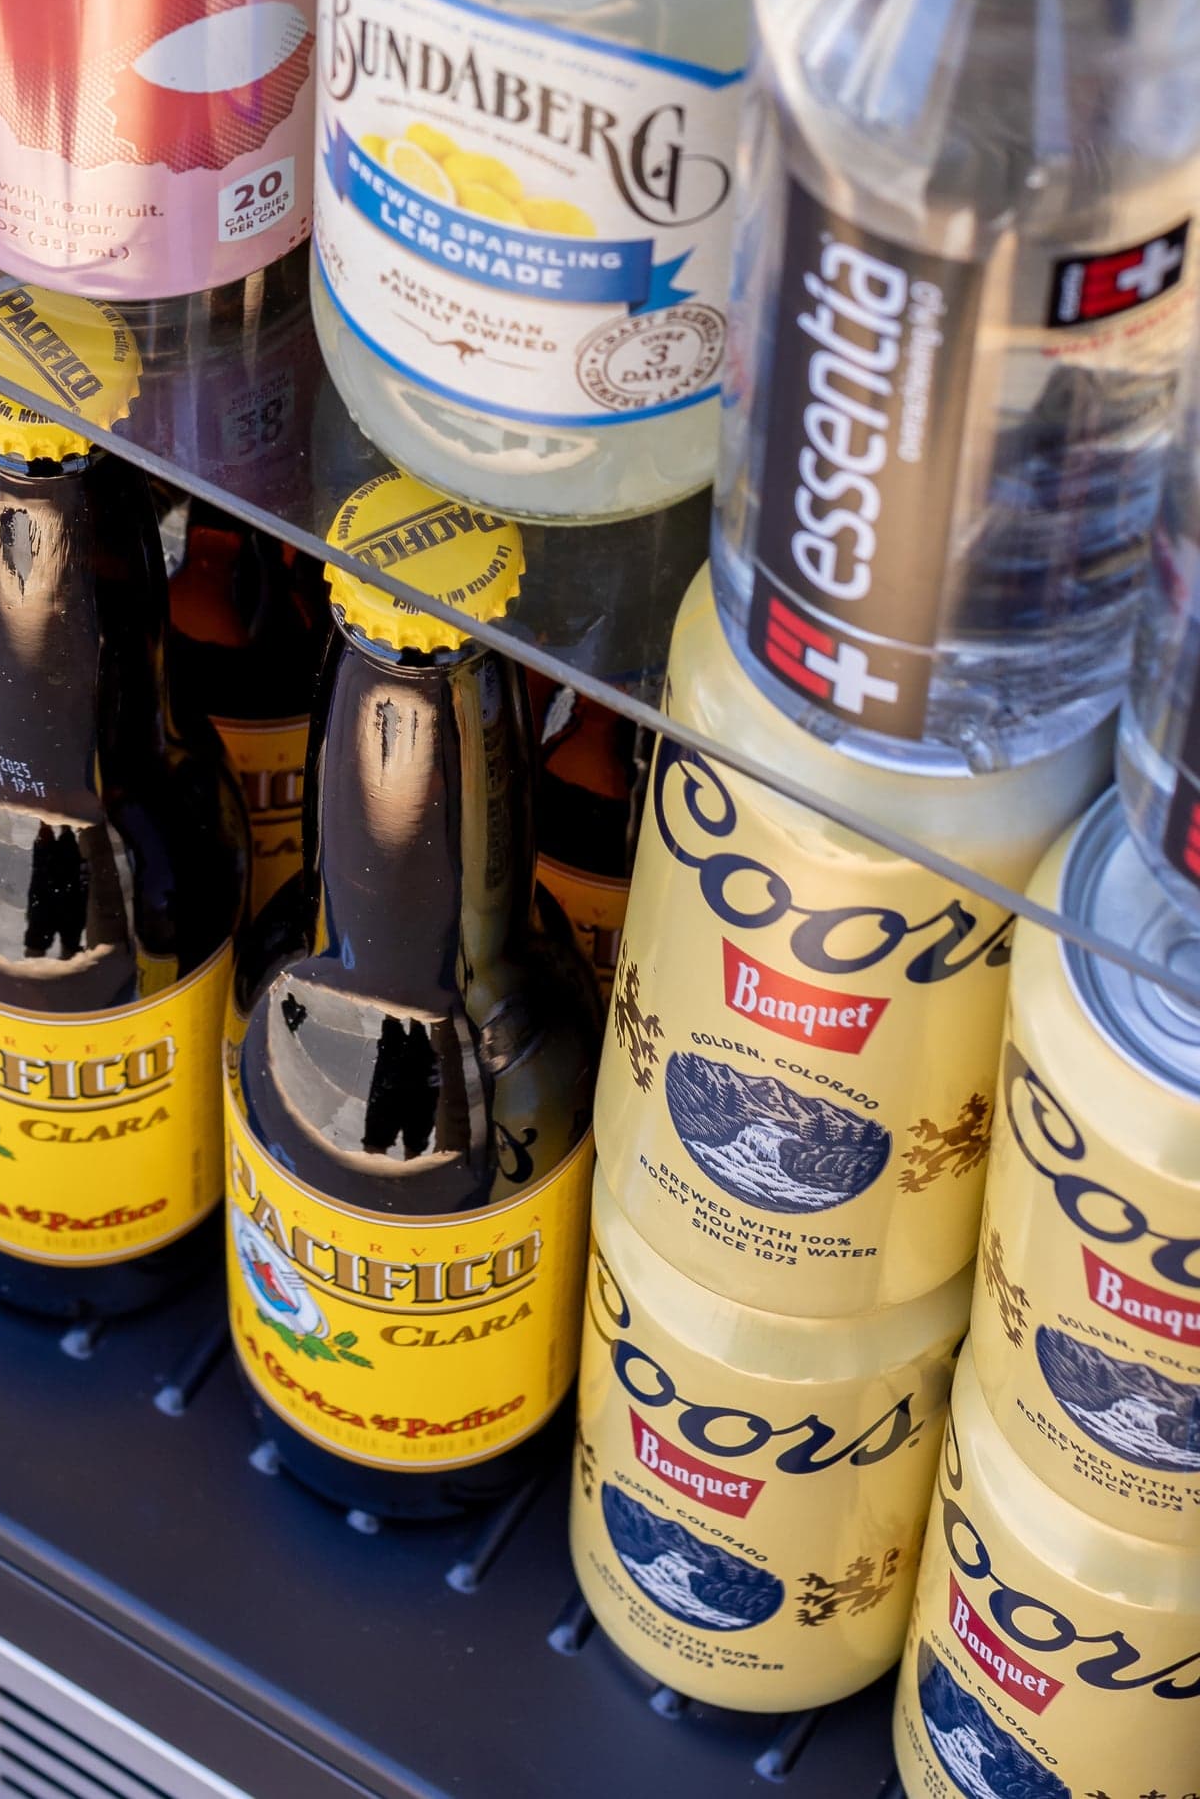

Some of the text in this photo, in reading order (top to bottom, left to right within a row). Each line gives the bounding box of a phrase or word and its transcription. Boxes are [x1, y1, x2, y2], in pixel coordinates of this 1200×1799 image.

[106, 202, 165, 219] fruit.
[224, 190, 290, 227] CALORIES
[229, 203, 287, 237] PER CAN
[233, 168, 284, 212] 20
[347, 151, 623, 270] BREWED SPARKLING
[379, 204, 565, 289] LEMONADE
[378, 272, 558, 354] FAMILY OWNED
[388, 265, 544, 337] AUSTRALIAN
[620, 364, 683, 385] DAYS
[645, 342, 669, 370] 3
[790, 241, 907, 601] essentia
[732, 960, 874, 1039] Banquet
[690, 1030, 880, 1110] GOLDEN, COLORADO
[18, 1106, 171, 1144] CLARA
[292, 1208, 543, 1258] CERVEZA
[639, 1152, 879, 1259] ROCKY MOUNTAIN WATER
[659, 1162, 852, 1247] BREWED WITH 100%
[691, 1216, 798, 1266] SINCE 1873
[379, 1302, 534, 1348] CLARA
[1057, 1313, 1135, 1353] GOLDEN,
[1096, 1266, 1200, 1338] Banqu
[639, 1428, 754, 1503] Banquet
[1016, 1397, 1183, 1503] ROCKY MOUNTAIN
[1036, 1411, 1176, 1492] BREWED WITH
[1072, 1462, 1184, 1513] SINCE 1873
[675, 1507, 769, 1563] COLORADO
[663, 1618, 761, 1662] WITH 100%
[720, 1655, 785, 1672] WATER
[952, 1594, 1051, 1697] Banquet
[976, 1684, 1059, 1766] COLORADO
